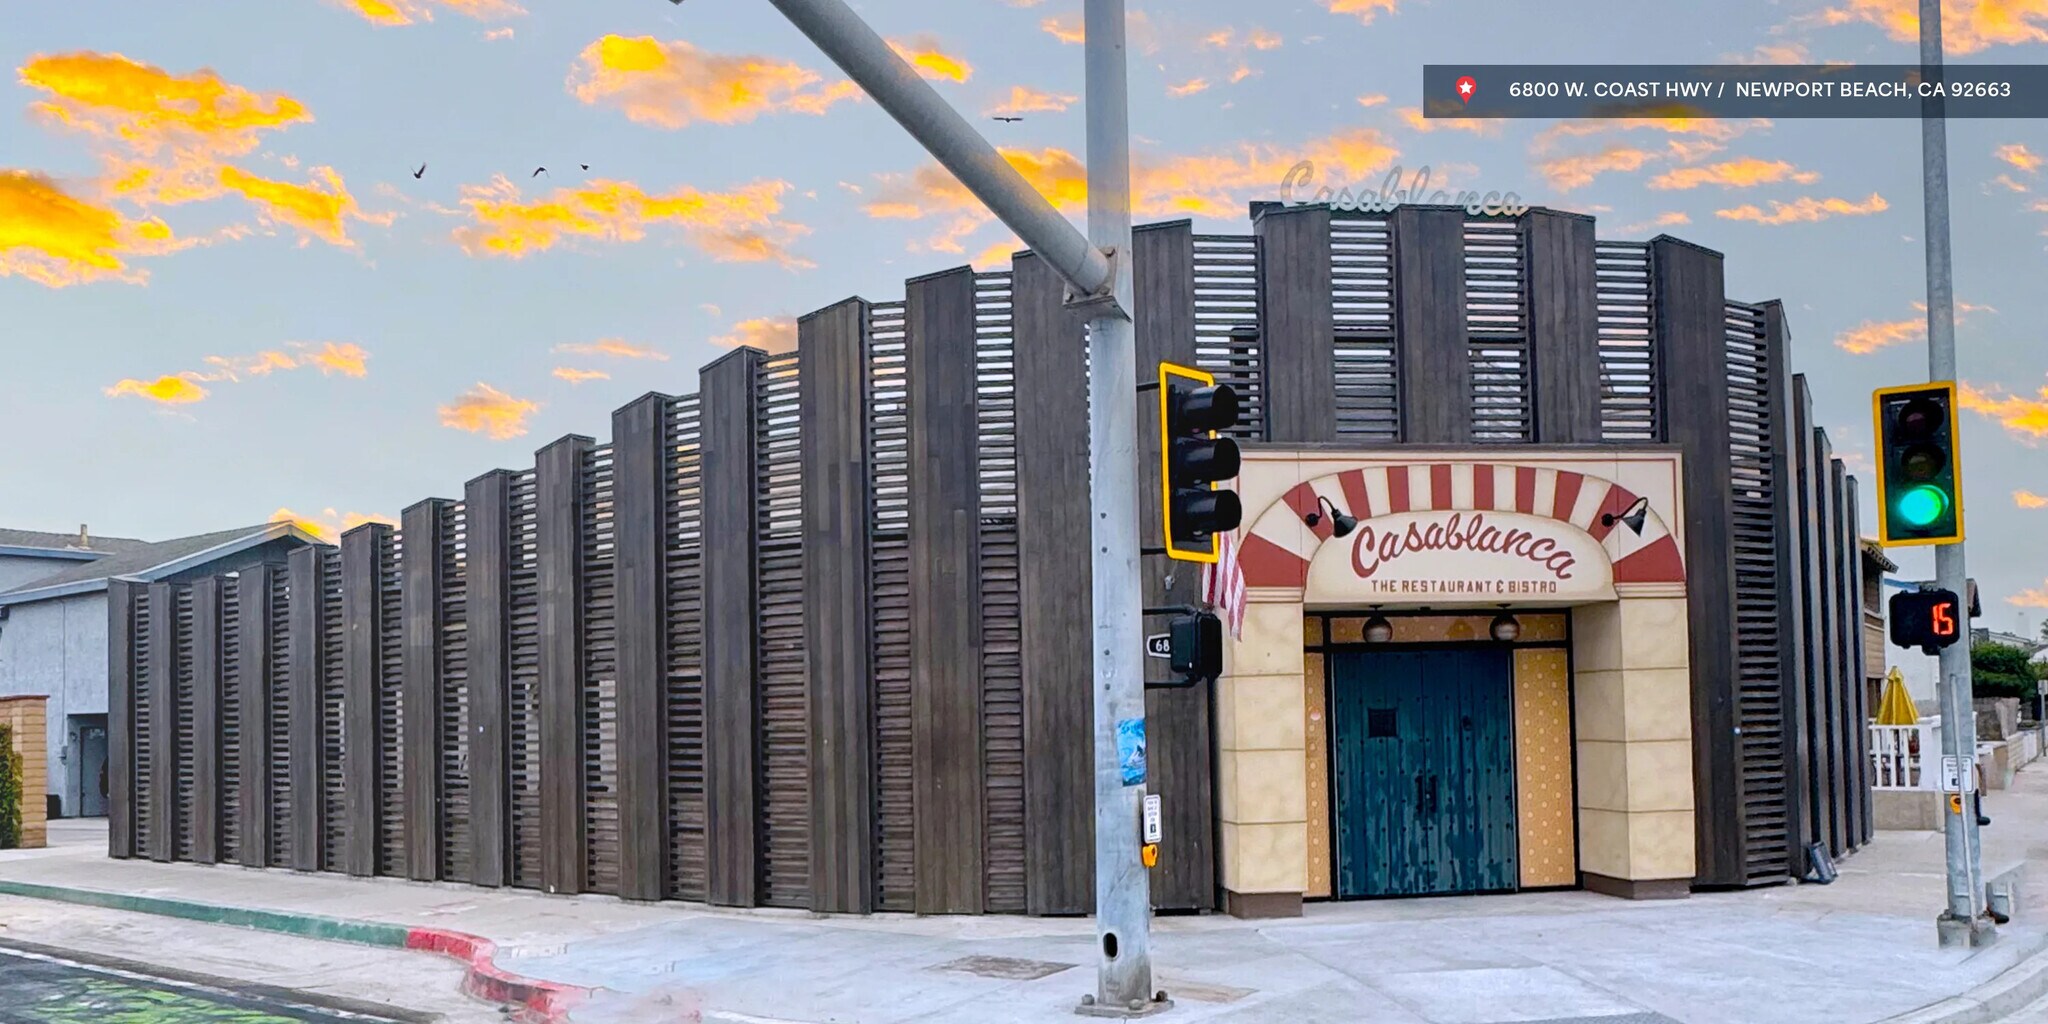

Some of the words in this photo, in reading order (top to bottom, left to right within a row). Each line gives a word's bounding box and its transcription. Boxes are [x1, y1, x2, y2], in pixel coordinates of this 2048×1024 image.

[1280, 160, 1529, 216] Casablanca
[1351, 512, 1576, 579] Casablanca
[1372, 580, 1397, 593] THE
[1402, 580, 1492, 593] RESTAURANT
[1509, 580, 1557, 593] BISTRO
[1932, 603, 1954, 635] 15
